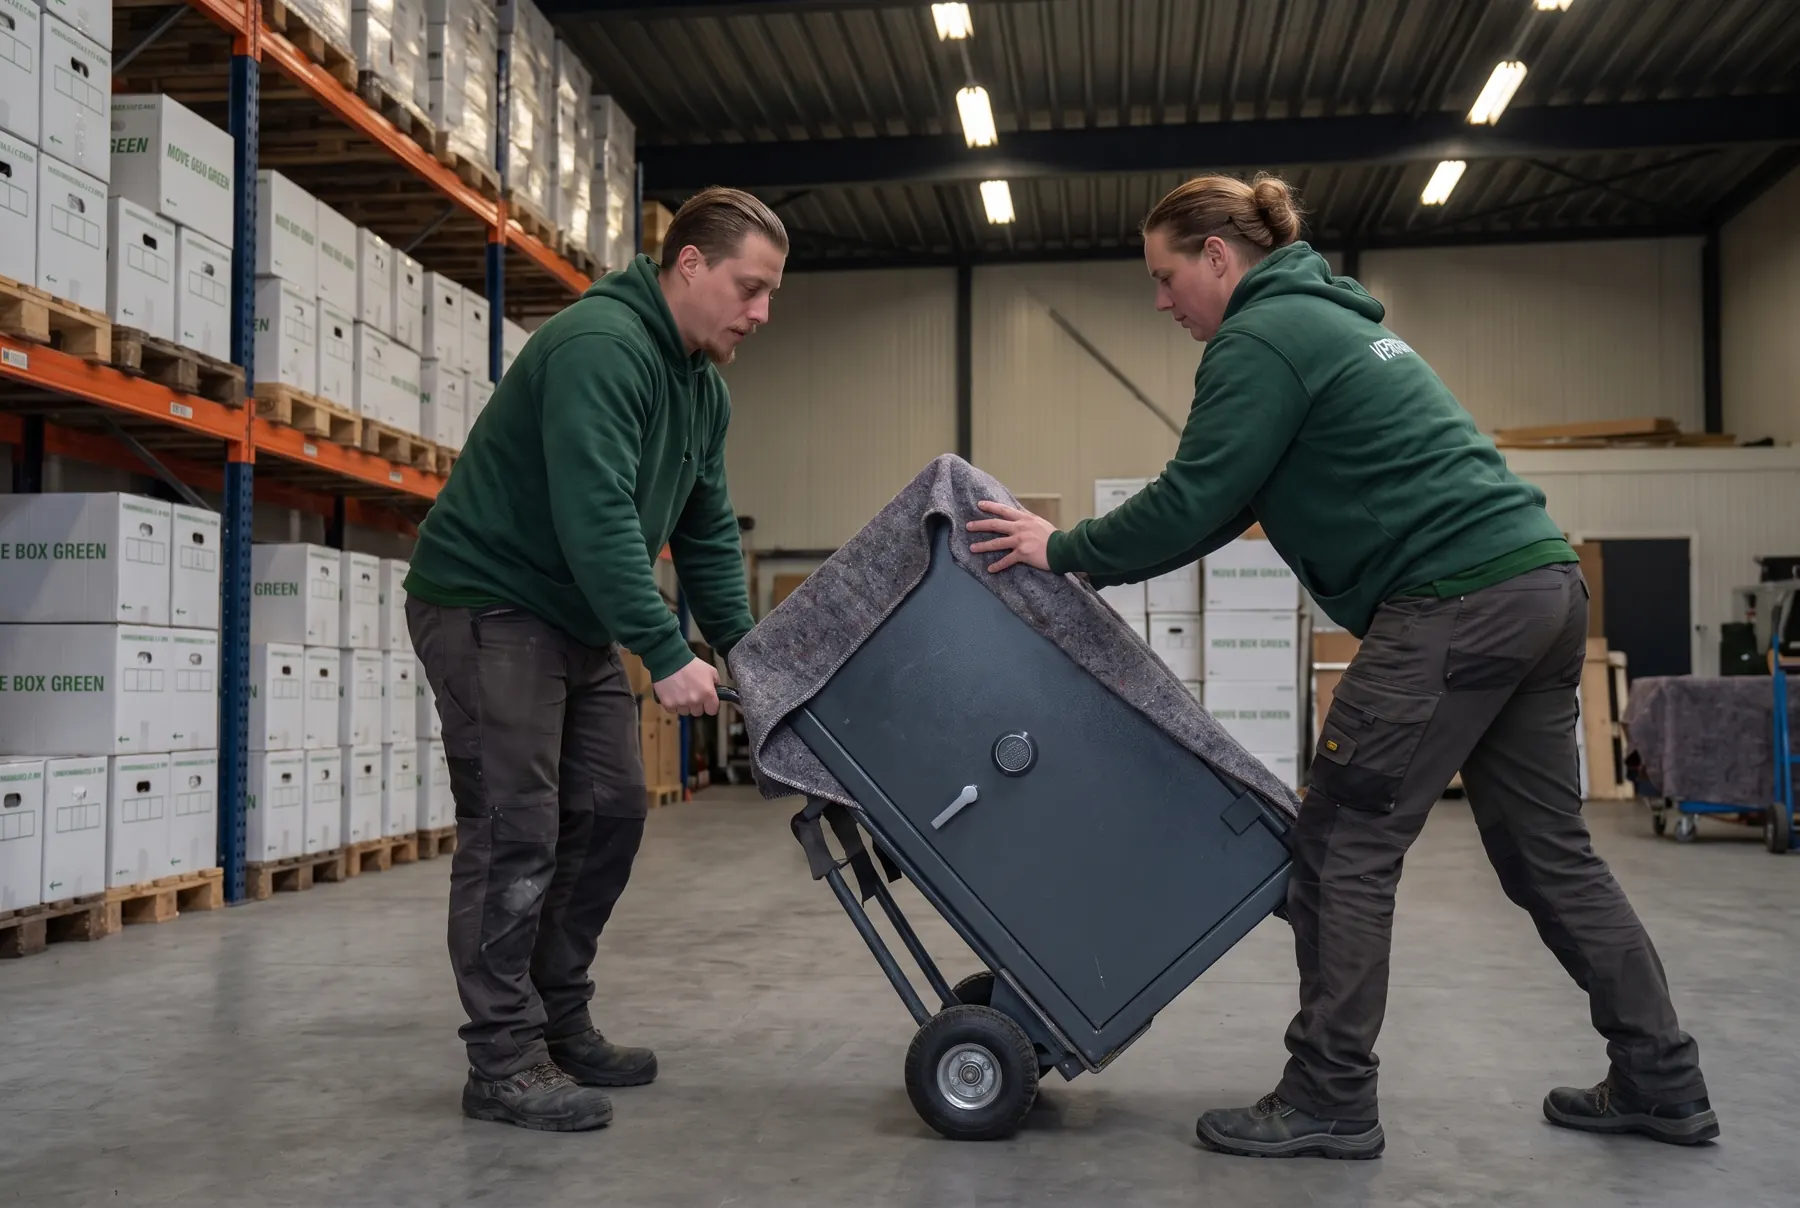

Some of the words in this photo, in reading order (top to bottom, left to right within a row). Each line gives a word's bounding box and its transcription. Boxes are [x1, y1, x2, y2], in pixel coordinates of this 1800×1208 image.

[166, 143, 191, 169] MOVE
[15, 543, 48, 560] BOX
[53, 542, 107, 560] GREEN
[254, 581, 299, 597] GREEN
[13, 675, 46, 692] BOX
[51, 674, 105, 692] GREEN
